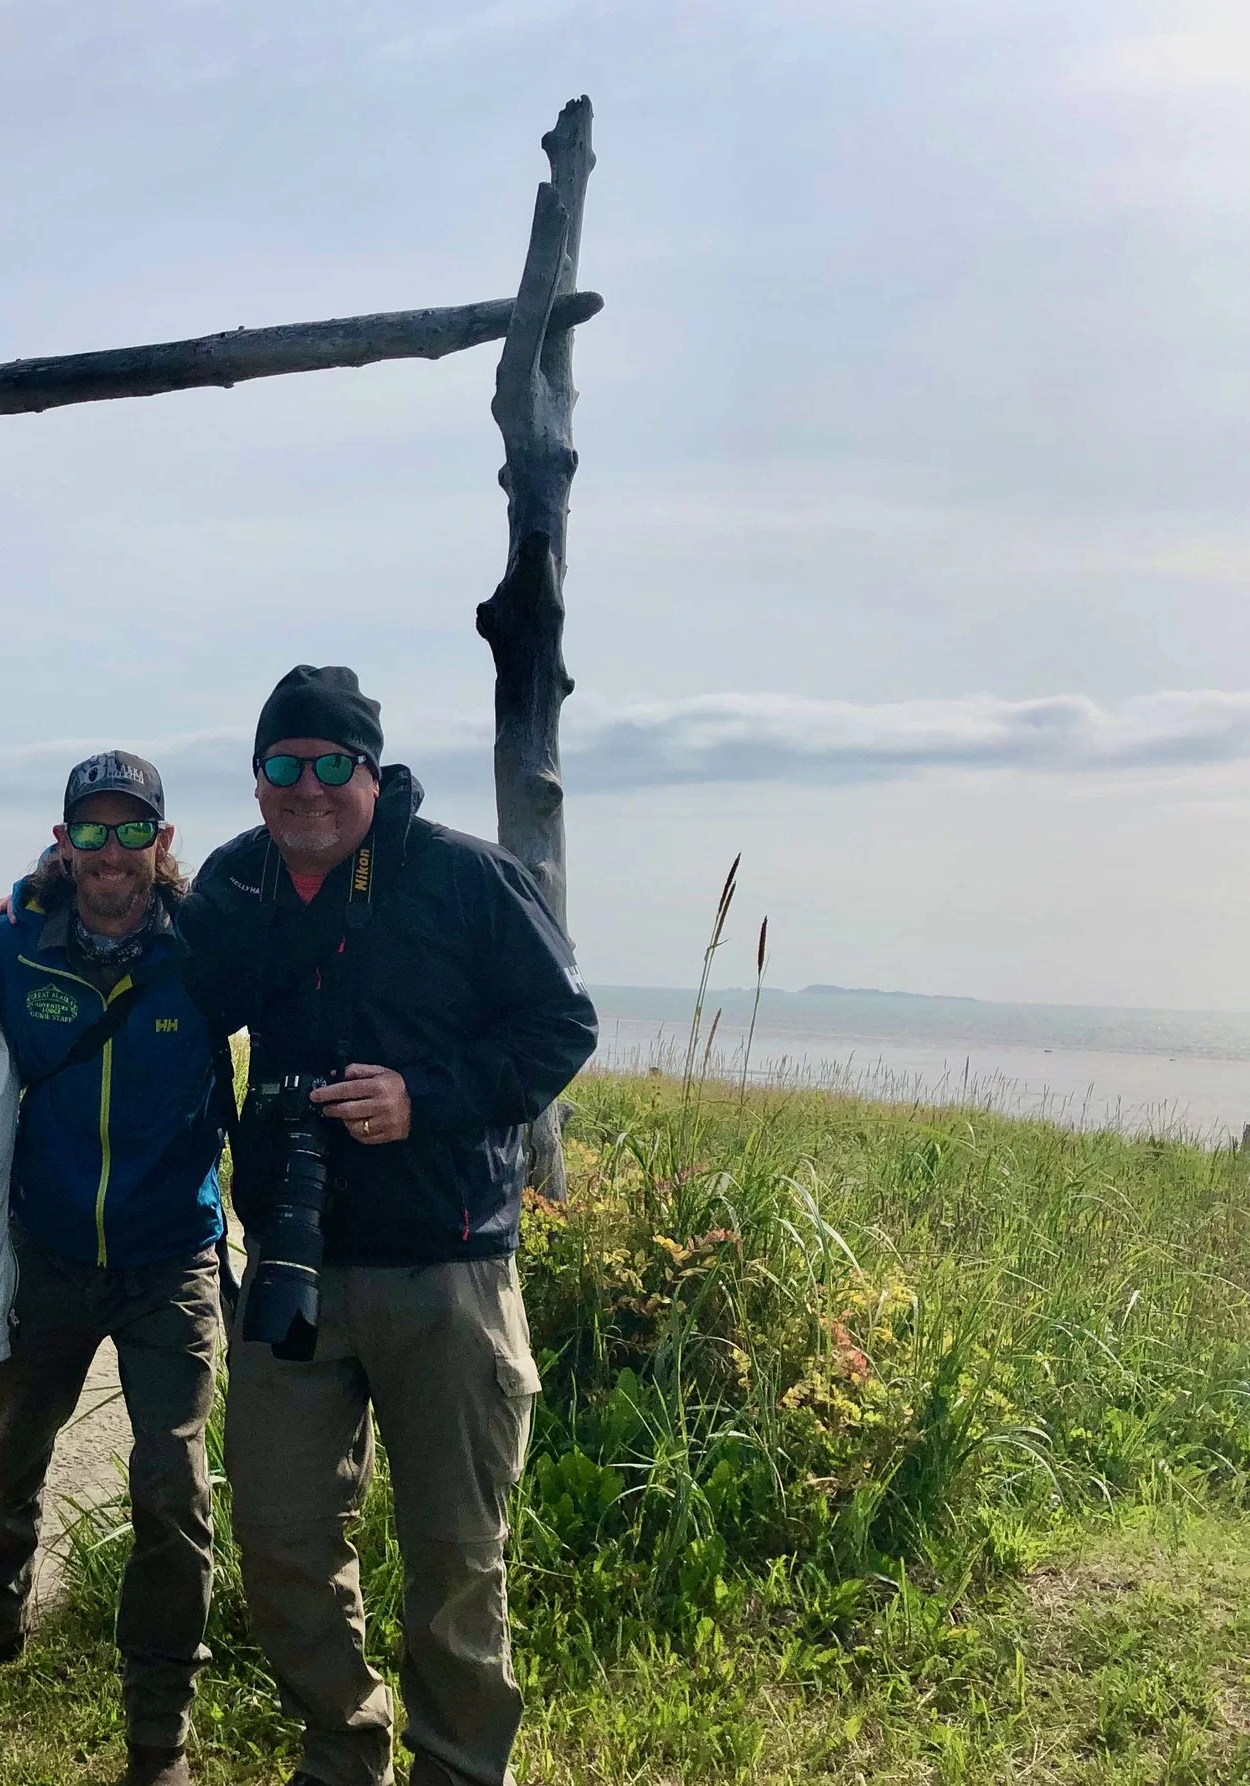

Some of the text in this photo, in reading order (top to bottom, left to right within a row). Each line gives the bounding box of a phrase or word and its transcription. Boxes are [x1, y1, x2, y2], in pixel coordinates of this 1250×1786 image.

[354, 849, 370, 891] Nikon
[230, 876, 250, 892] HELLY
[30, 991, 75, 1006] GREAT ALASKA
[52, 1015, 72, 1023] STAFF
[155, 1018, 179, 1033] HH
